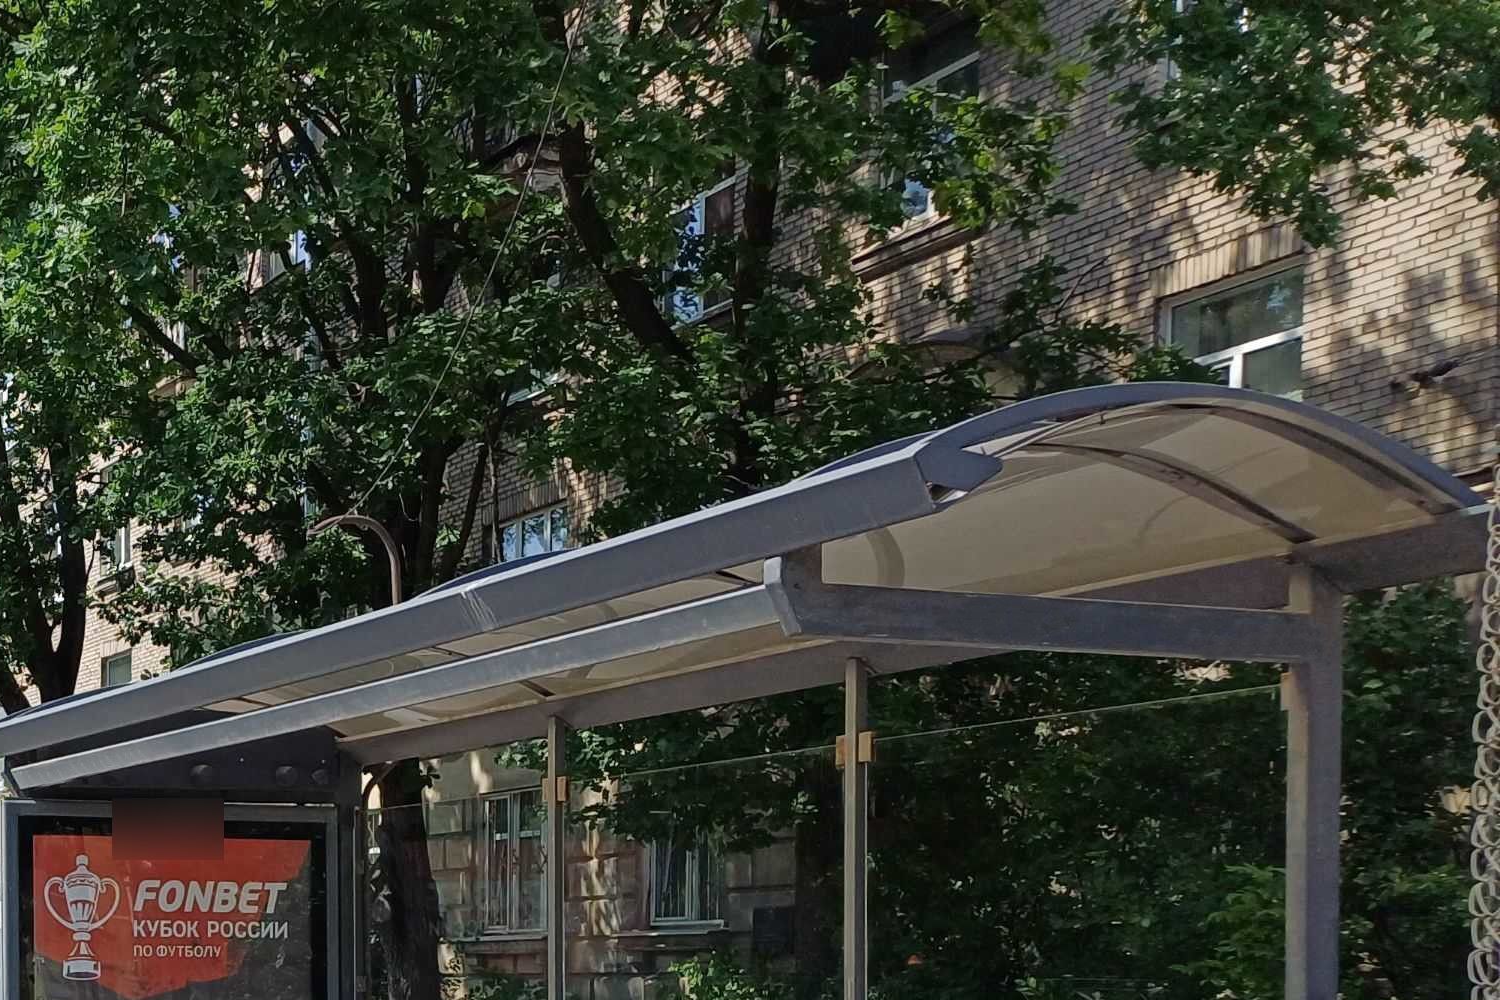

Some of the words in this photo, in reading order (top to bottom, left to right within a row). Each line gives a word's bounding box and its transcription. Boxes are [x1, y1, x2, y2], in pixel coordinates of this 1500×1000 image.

[133, 880, 287, 913] FONBET
[133, 919, 199, 938] КУБОК
[207, 921, 289, 939] РОССИИ
[133, 945, 153, 957] ПО
[156, 945, 221, 958] ФУТБОЛУ
